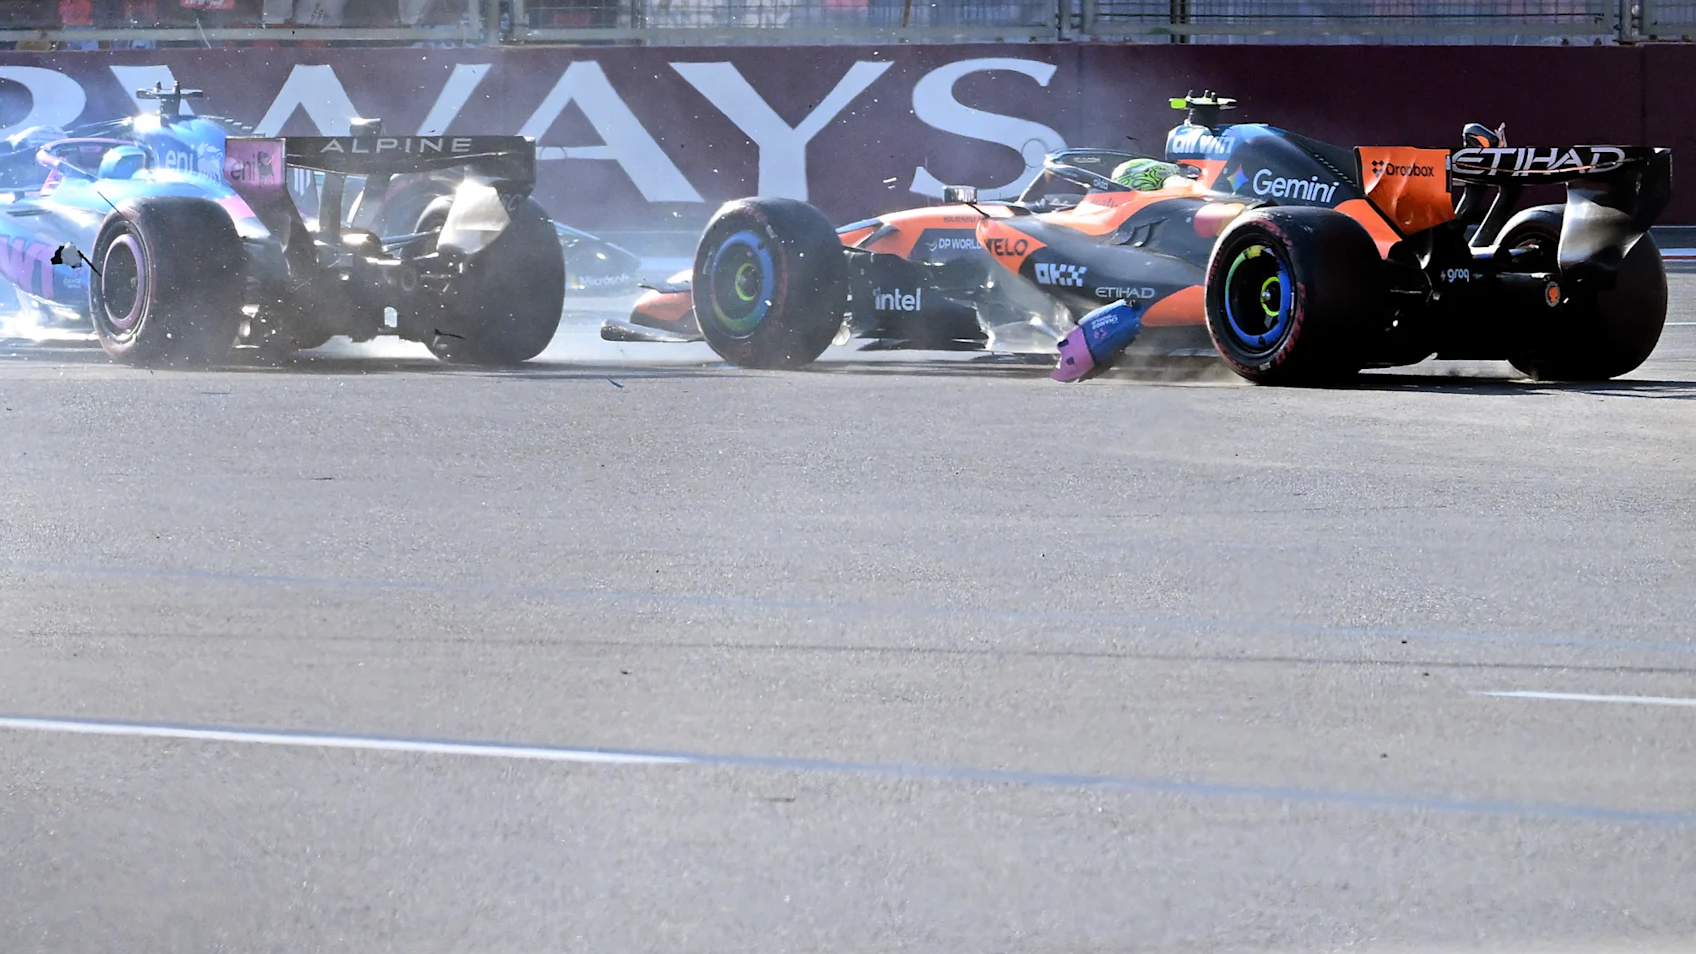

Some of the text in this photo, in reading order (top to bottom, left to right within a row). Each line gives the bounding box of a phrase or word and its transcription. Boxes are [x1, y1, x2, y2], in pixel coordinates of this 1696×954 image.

[320, 137, 472, 154] ALPINE
[165, 149, 195, 172] eni
[1451, 147, 1626, 176] ETIHAD
[1386, 162, 1435, 178] Dropbox
[1252, 168, 1340, 203] Gemini
[938, 237, 951, 250] DP
[985, 238, 1029, 256] VELO
[1035, 262, 1087, 287] OKX
[1447, 268, 1470, 283] groq
[874, 288, 922, 312] intel
[1095, 286, 1156, 299] ETIHAD
